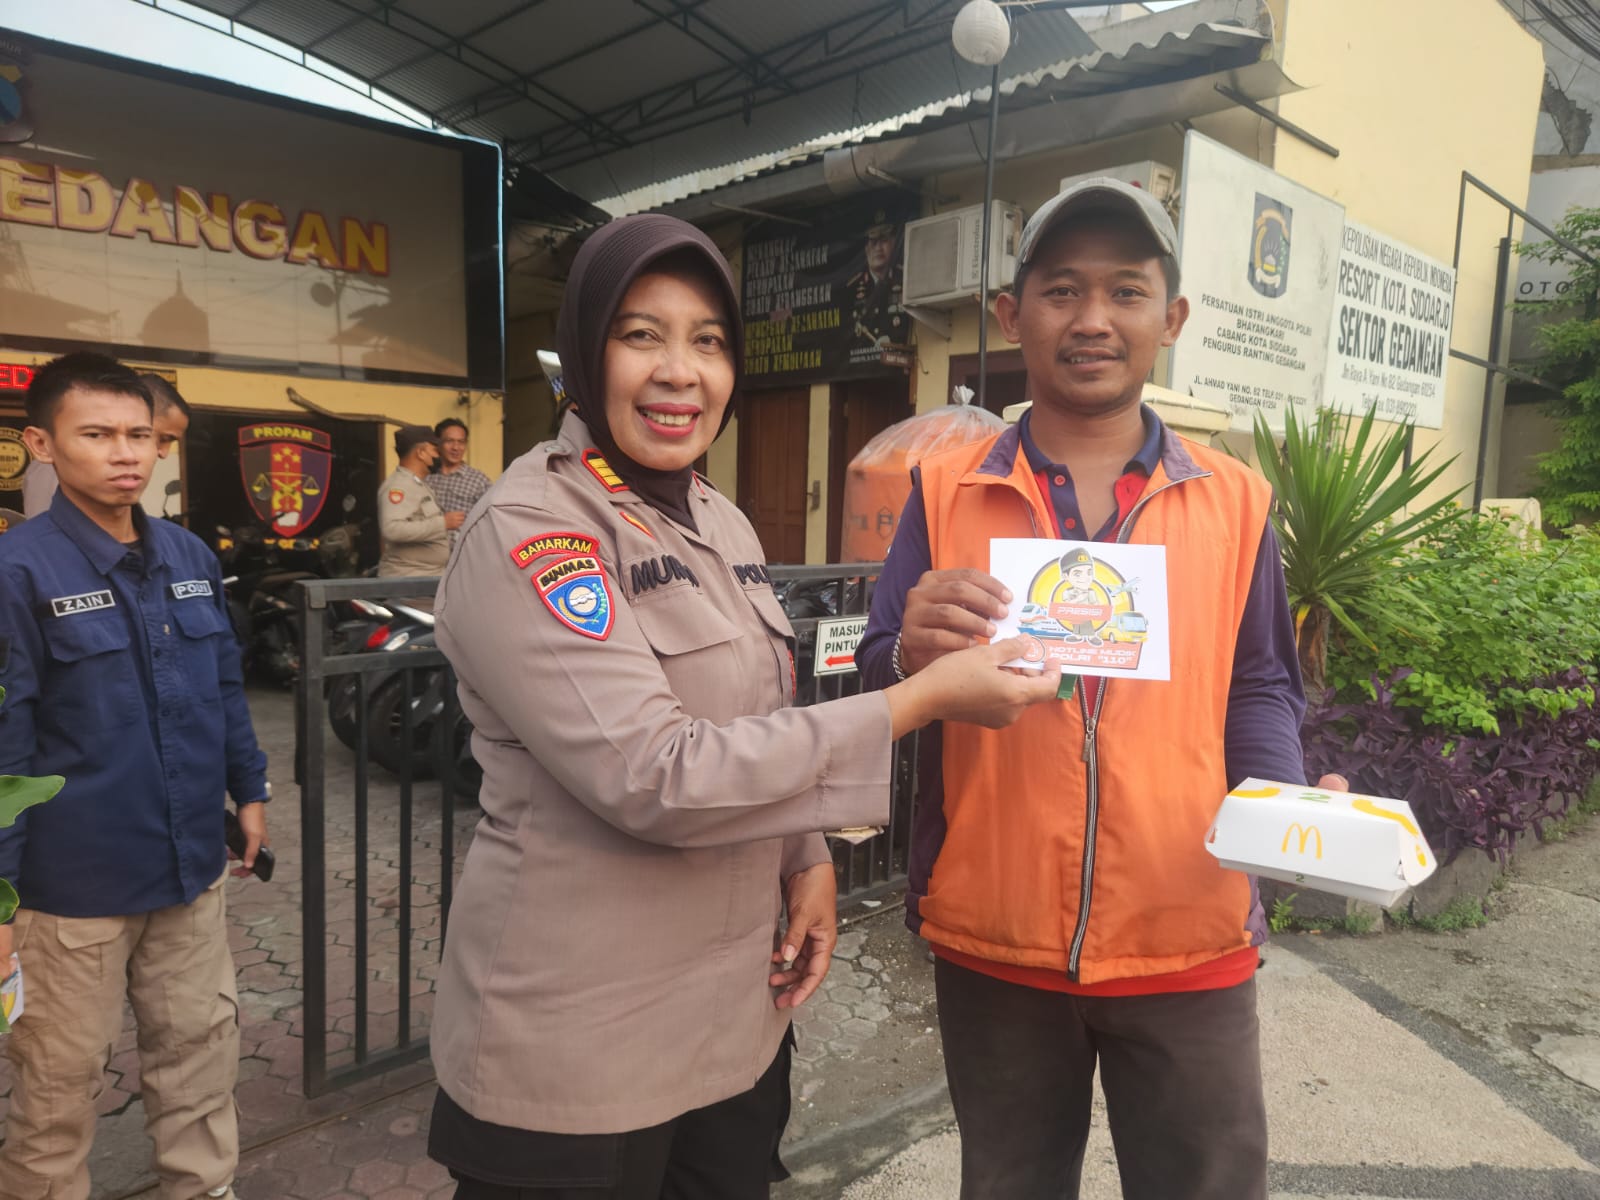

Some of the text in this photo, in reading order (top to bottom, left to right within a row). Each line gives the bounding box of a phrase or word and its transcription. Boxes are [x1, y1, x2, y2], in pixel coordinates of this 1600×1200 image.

[0, 157, 389, 276] EDANGAN
[1342, 226, 1452, 295] KEPOLISIAN NEGARA REPUBLIK INDONESIA
[1338, 259, 1450, 331] RESORT KOTA SIDOARJO
[1202, 294, 1312, 336] PERSATUAN ISTRI ANGGOTA POLRI
[1237, 318, 1285, 340] BHAYANGKARI
[1217, 327, 1298, 357] CABANG KOTA SIDOARJO
[1338, 305, 1445, 378] SEKTOR GEDANGAN
[1202, 337, 1306, 371] PENGURUS RANTING GEDANGAN
[1227, 382, 1240, 393] YANI
[1230, 393, 1261, 407] GEDANGAN
[253, 426, 313, 442] PROPAM
[519, 538, 592, 561] BAHARKAM
[540, 559, 595, 587] BINMAS
[62, 595, 105, 612] ZAIN
[824, 640, 857, 653] PINTU
[1049, 645, 1097, 656] HOTLINE
[1050, 653, 1091, 662] POLRI
